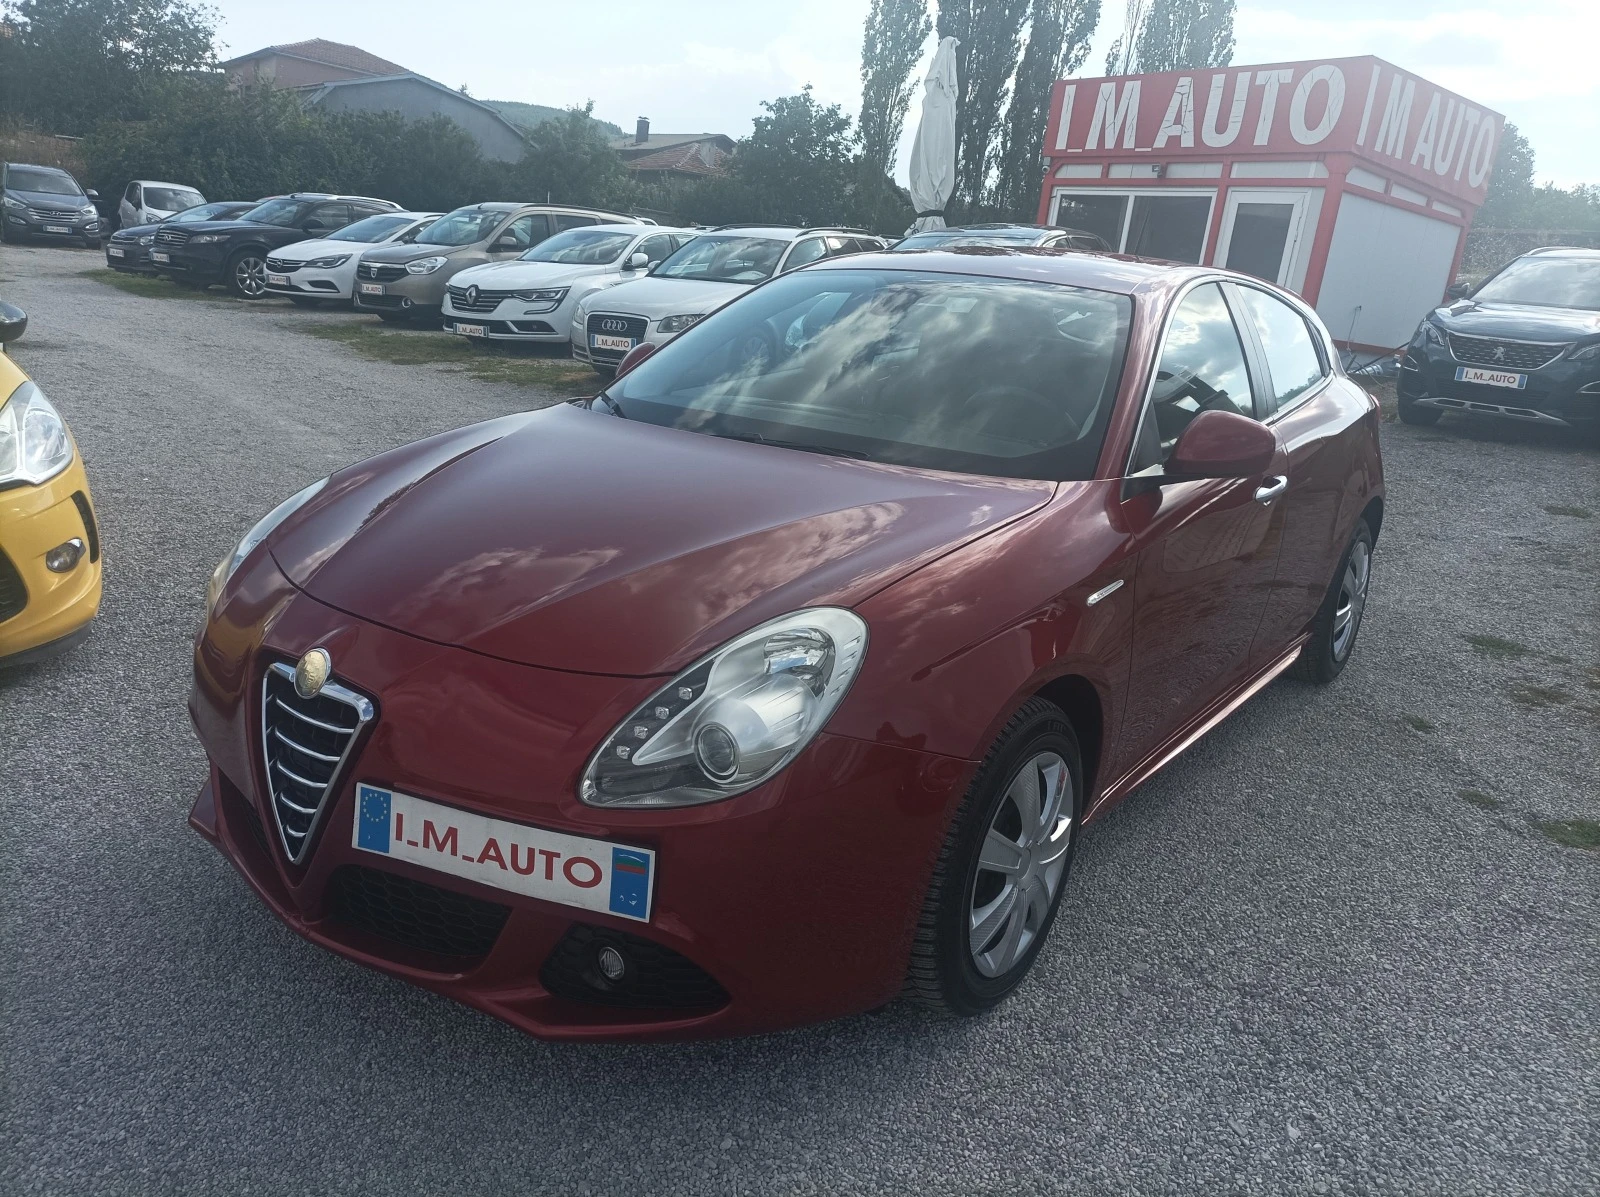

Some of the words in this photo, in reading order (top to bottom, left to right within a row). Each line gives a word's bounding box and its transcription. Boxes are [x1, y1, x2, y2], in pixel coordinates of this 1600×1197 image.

[1356, 64, 1381, 146] I
[1374, 73, 1416, 160] M
[1410, 91, 1495, 188] AUTO
[597, 337, 629, 348] I_M_AUTO
[1465, 370, 1516, 384] I_M_AUTO
[395, 812, 603, 889] I_M_AUTO
